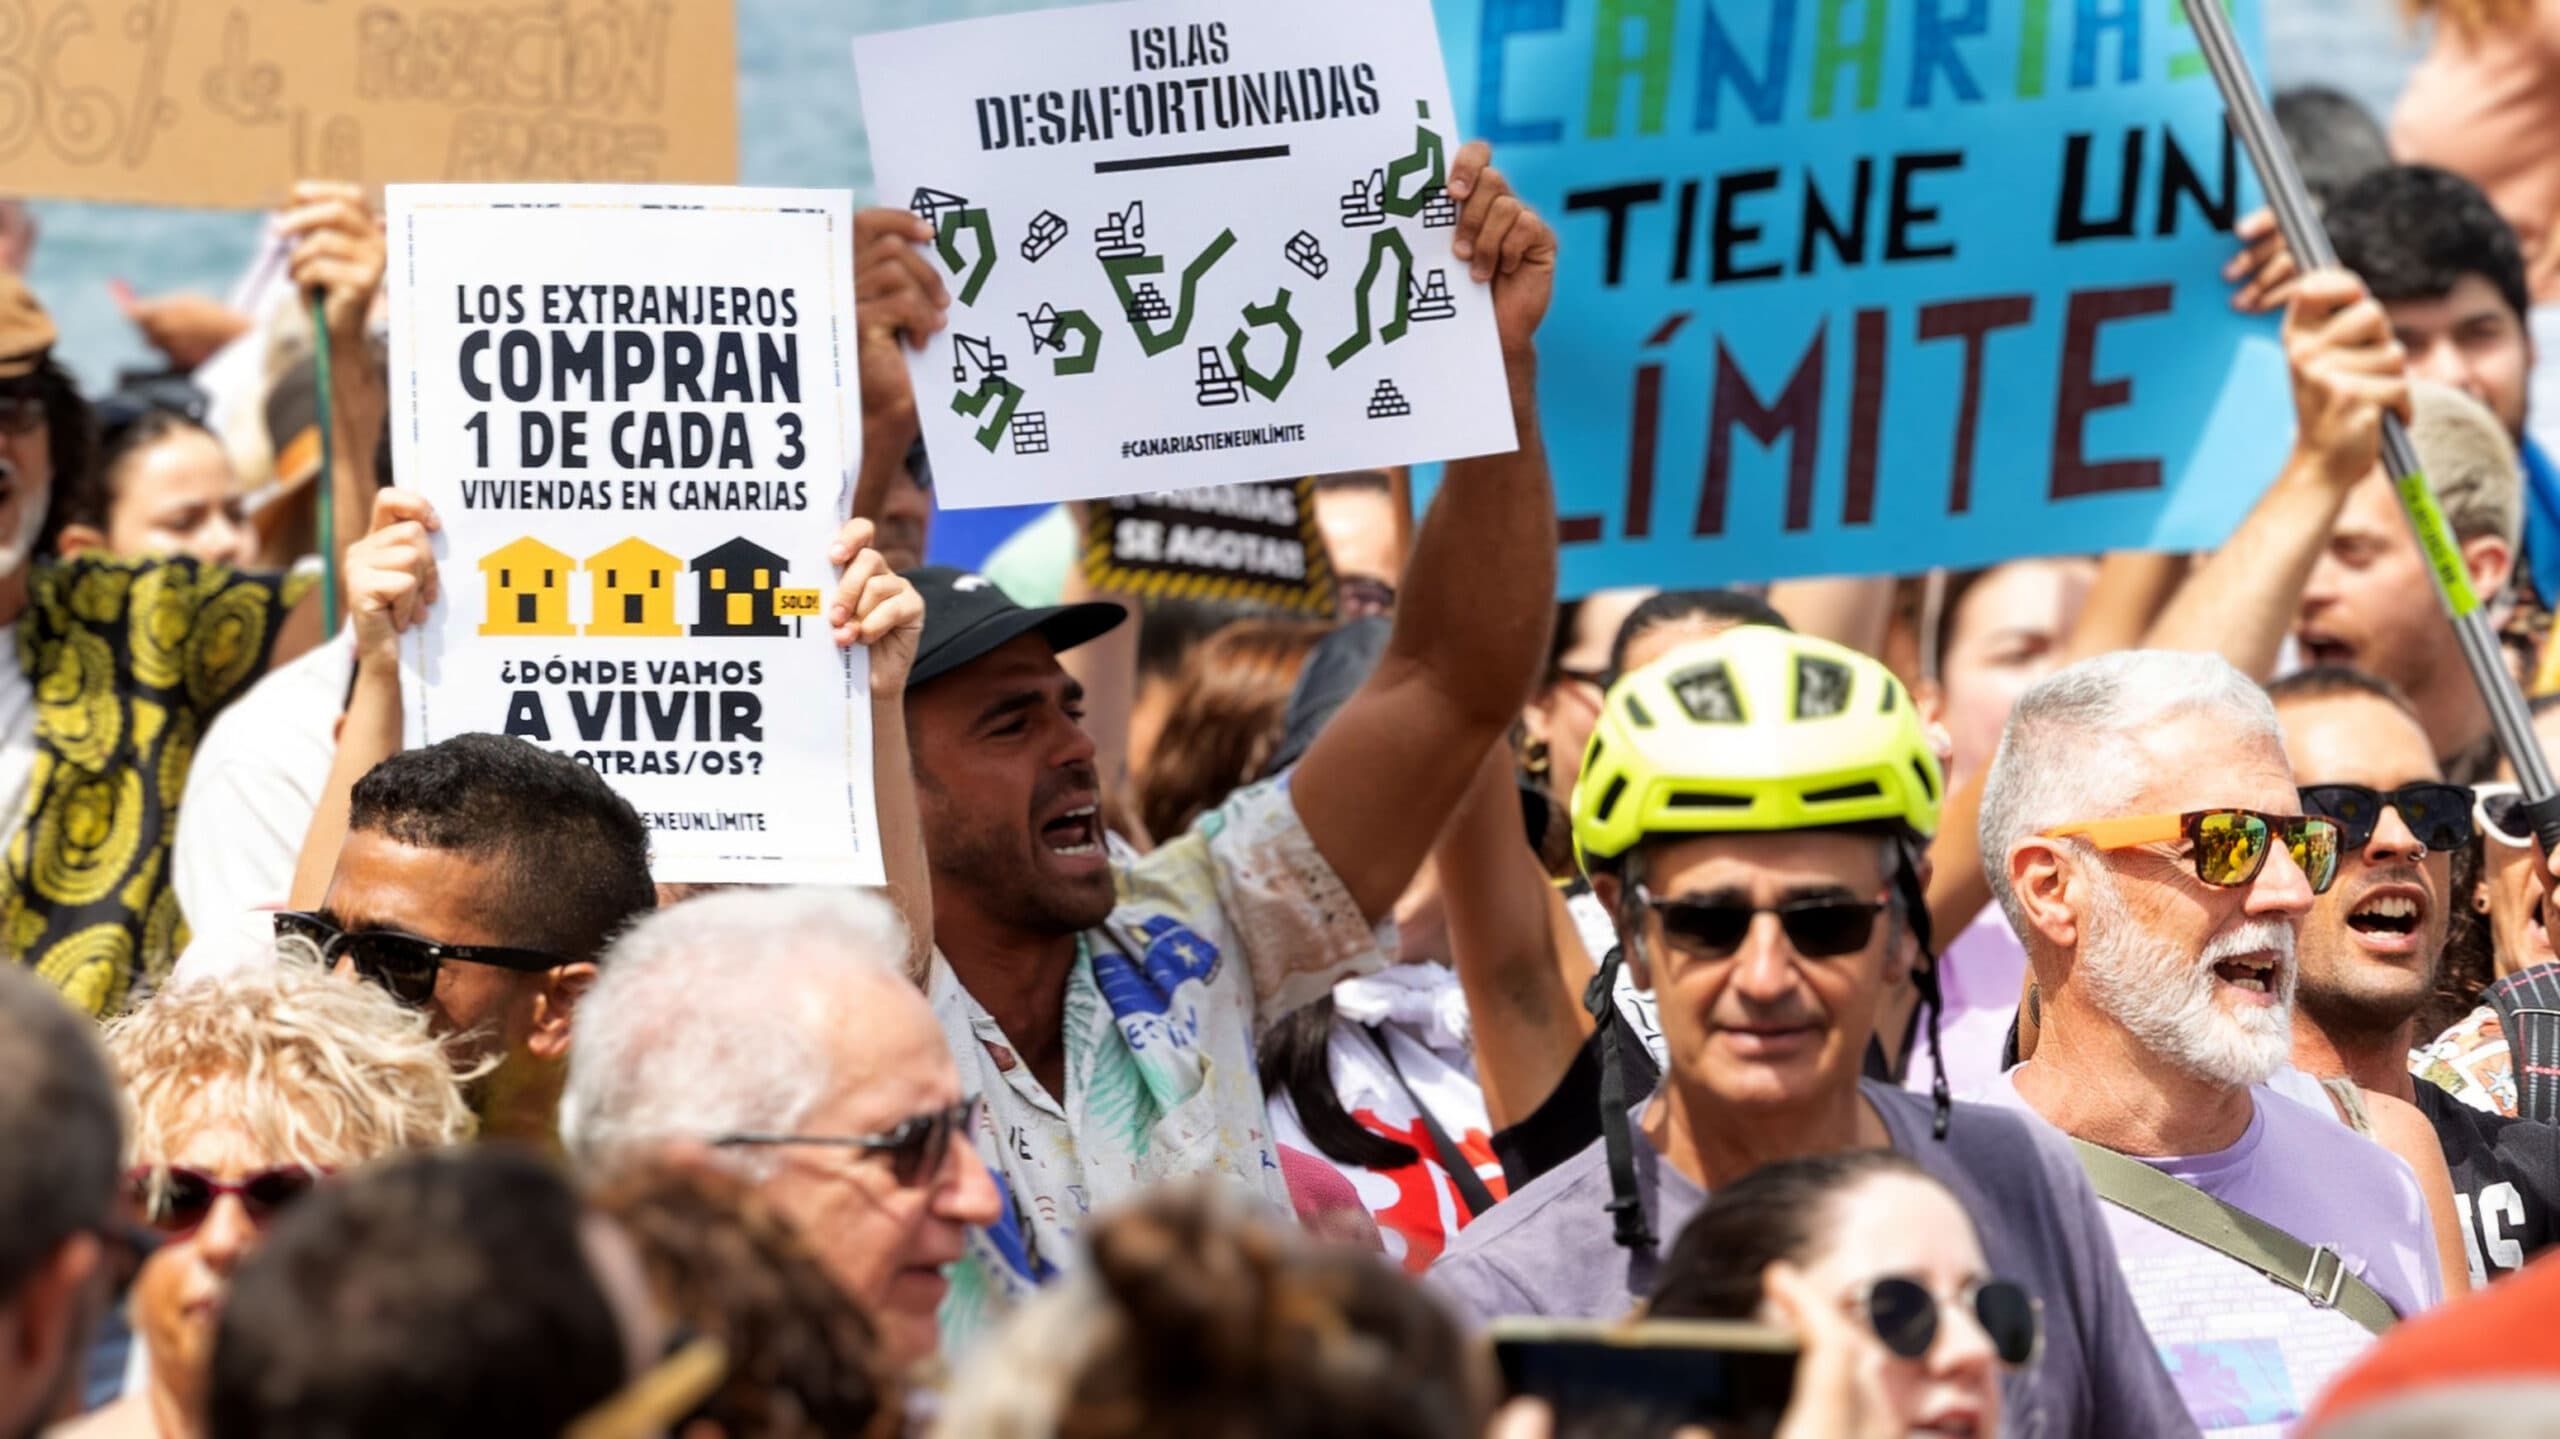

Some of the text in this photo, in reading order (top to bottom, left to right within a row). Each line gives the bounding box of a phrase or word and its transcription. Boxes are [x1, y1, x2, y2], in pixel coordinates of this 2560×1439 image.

[1131, 21, 1230, 71] ISLAS
[975, 63, 1381, 152] DESAFORTUNADAS
[1563, 108, 2238, 287] TIENE UN
[456, 284, 799, 328] LOS EXTRANJEROS
[459, 329, 802, 404] COMPRAN
[1558, 281, 2176, 545] ÍMITE
[464, 410, 807, 471] 1 DE CADA 3
[1121, 424, 1306, 458] #CANARIASTIENEUNLÍMITE
[461, 480, 808, 511] VIVIENDAS EN CANARIAS
[500, 655, 763, 685] ¿DÓNDE VAMOS
[504, 690, 763, 743] A VIVIR
[574, 750, 763, 775] OTRAS/OS?
